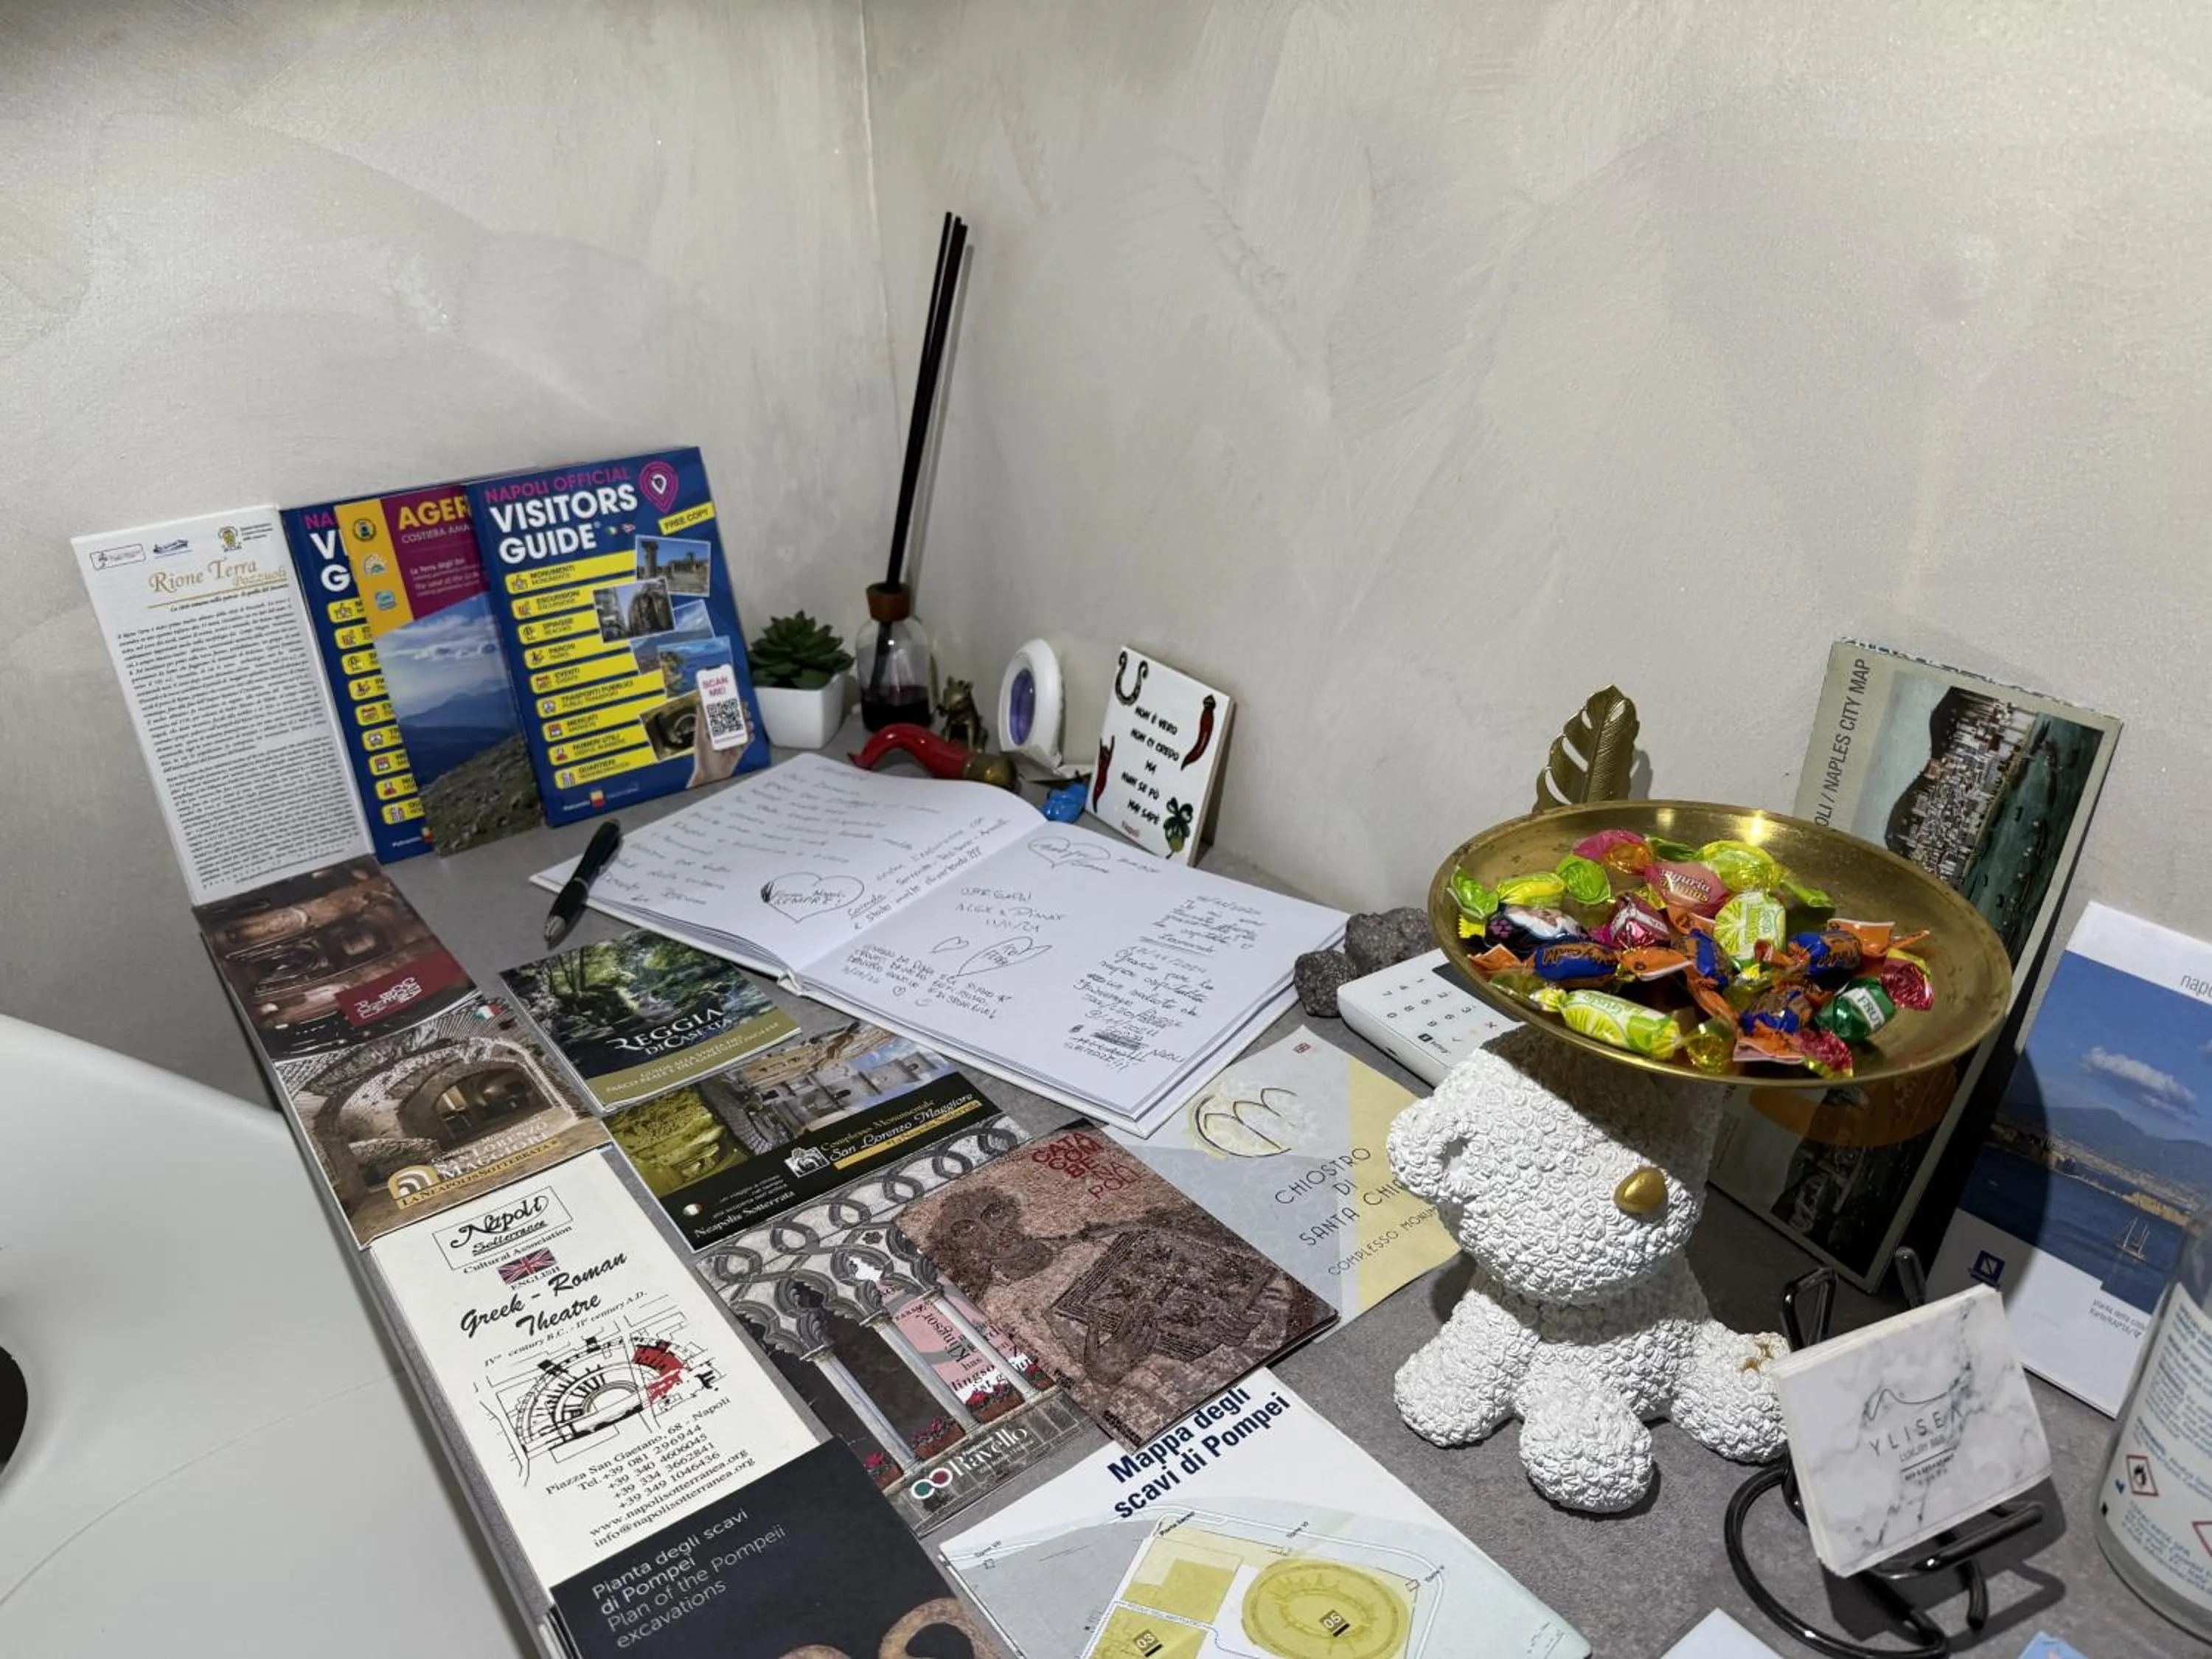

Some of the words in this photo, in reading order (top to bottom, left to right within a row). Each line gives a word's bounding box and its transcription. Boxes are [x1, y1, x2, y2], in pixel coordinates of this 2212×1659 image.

[485, 480, 549, 503] NAPOLI
[553, 467, 630, 491] OFFICIAL
[490, 484, 637, 534] VISITORS
[663, 515, 685, 530] FREE
[686, 509, 709, 524] COPY
[401, 529, 446, 544] COSTIERA
[499, 524, 597, 564] GUIDE
[148, 569, 204, 593] Rione
[208, 558, 257, 581] Terra
[702, 676, 729, 692] SCAN
[1135, 706, 1150, 720] NON
[1158, 718, 1178, 735] VERO
[1825, 733, 1851, 788] NAPLES
[1840, 694, 1858, 730] CITY
[1849, 658, 1871, 695] MAP
[1130, 728, 1147, 742] NON
[1155, 742, 1179, 761] CREDO
[605, 1008, 726, 1050] REGGIA
[830, 1144, 858, 1163] San
[860, 1121, 912, 1149] Lorenzo
[1276, 1147, 1371, 1204] CHIOSTRO
[1333, 1180, 1357, 1196] DI
[450, 1195, 549, 1249] Napoli
[694, 1214, 742, 1238] Neapolis
[1299, 1206, 1360, 1246] SANTA
[464, 1252, 511, 1274] Cultural
[514, 1225, 573, 1254] Association
[1328, 1230, 1399, 1276] COMPLESSO
[460, 1293, 525, 1339] Greek
[548, 1252, 627, 1298] Roman
[510, 1266, 560, 1290] ENGLISH
[515, 1293, 602, 1336] Theatre
[546, 1473, 587, 1495] Piazza
[589, 1461, 612, 1475] San
[615, 1435, 667, 1464] Gaetano,
[667, 1422, 683, 1435] 68
[692, 1398, 731, 1424] Napoli
[577, 1476, 602, 1492] Tel.
[603, 1463, 623, 1481] +39
[627, 1453, 648, 1468] 081
[653, 1424, 702, 1455] 296944
[634, 1461, 655, 1478] 340
[660, 1433, 708, 1464] 4606045
[949, 1427, 1028, 1476] Ravello
[1107, 1426, 1194, 1484] Mappa
[1193, 1387, 1251, 1430] degli
[1114, 1465, 1180, 1518] scavi
[1180, 1447, 1208, 1475] di
[1200, 1391, 1291, 1458] Pompei
[590, 1447, 748, 1537] www.napolisotterranea.org
[613, 1483, 635, 1500] +39
[640, 1470, 661, 1486] 334
[665, 1441, 715, 1472] 3662841
[619, 1493, 641, 1510] +39
[644, 1479, 667, 1497] 349
[671, 1451, 720, 1482] 1046436
[594, 1457, 756, 1548] info@napolisotterranea.org
[592, 1557, 652, 1600] Pianta
[654, 1533, 701, 1570] degli
[703, 1509, 748, 1540] scavi
[600, 1596, 620, 1615] di
[622, 1554, 696, 1605] Pompei
[608, 1601, 651, 1632] Plan
[654, 1585, 676, 1607] of
[678, 1568, 709, 1595] the
[711, 1525, 787, 1573] Pompeii
[616, 1579, 727, 1649] excavations
[1322, 1612, 1342, 1630] 05
[1137, 1632, 1156, 1650] 03
